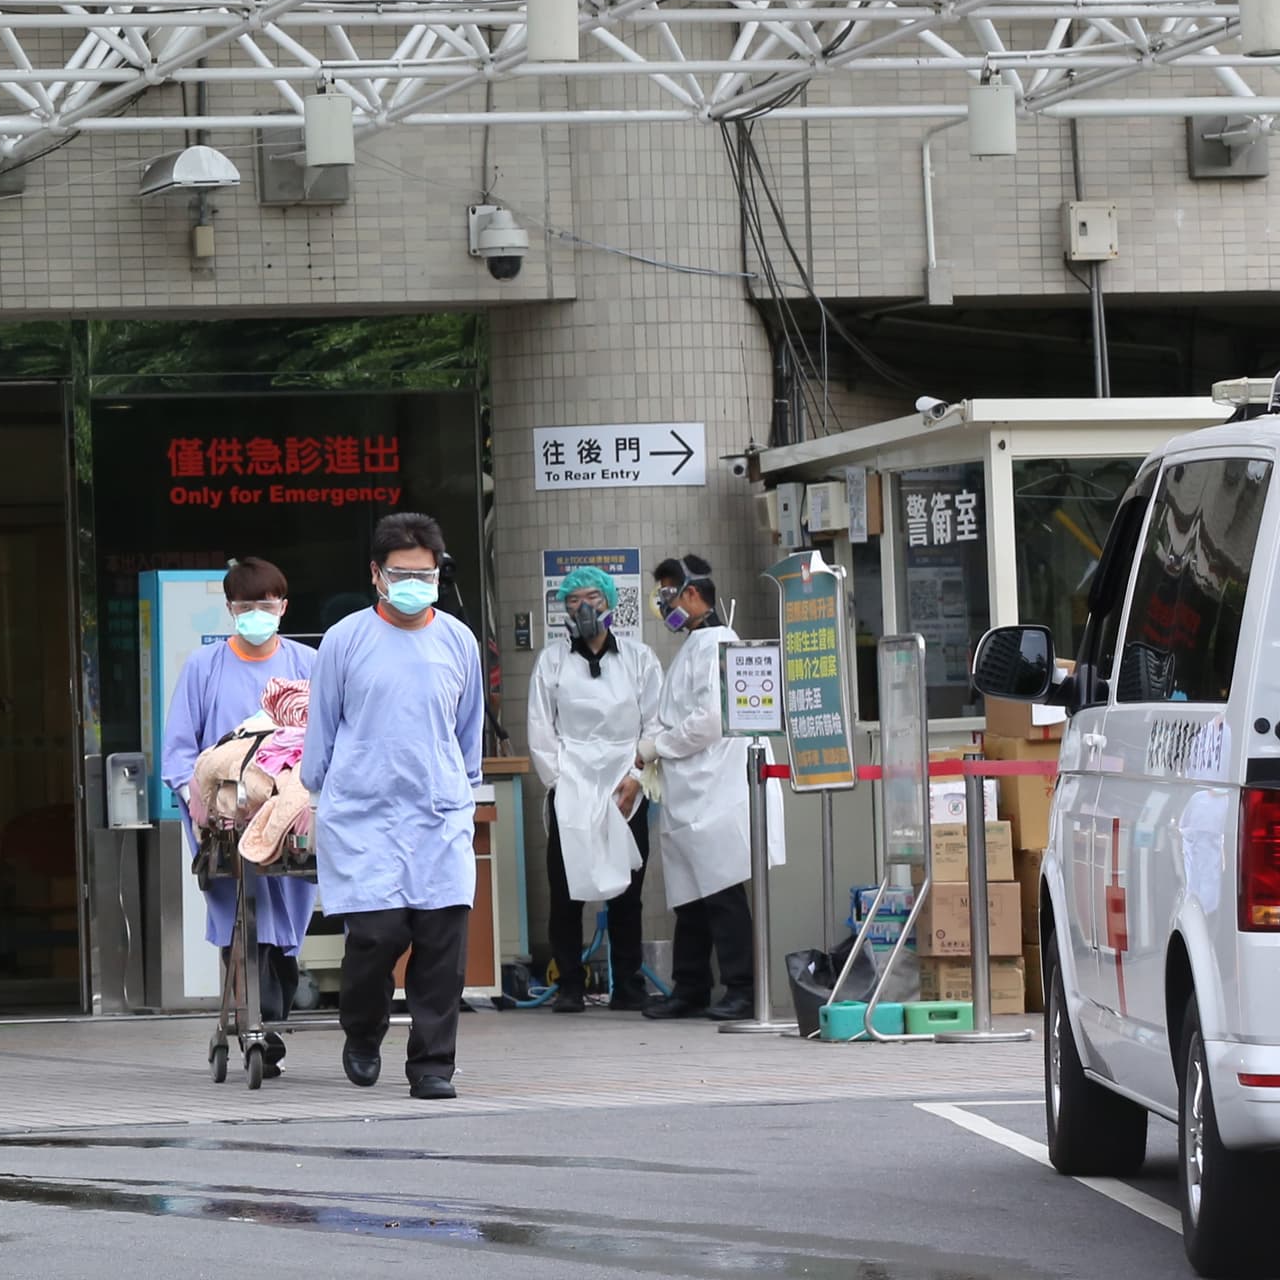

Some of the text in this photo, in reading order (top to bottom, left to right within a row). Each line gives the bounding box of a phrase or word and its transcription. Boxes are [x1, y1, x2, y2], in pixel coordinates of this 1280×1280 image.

[167, 435, 400, 477] 僅供急診進出
[542, 437, 641, 466] 往後門
[545, 468, 640, 484] To Rear Entry
[170, 485, 401, 508] Only for Emergency
[907, 489, 978, 547] 警衛室
[736, 656, 772, 666] 因應疫情
